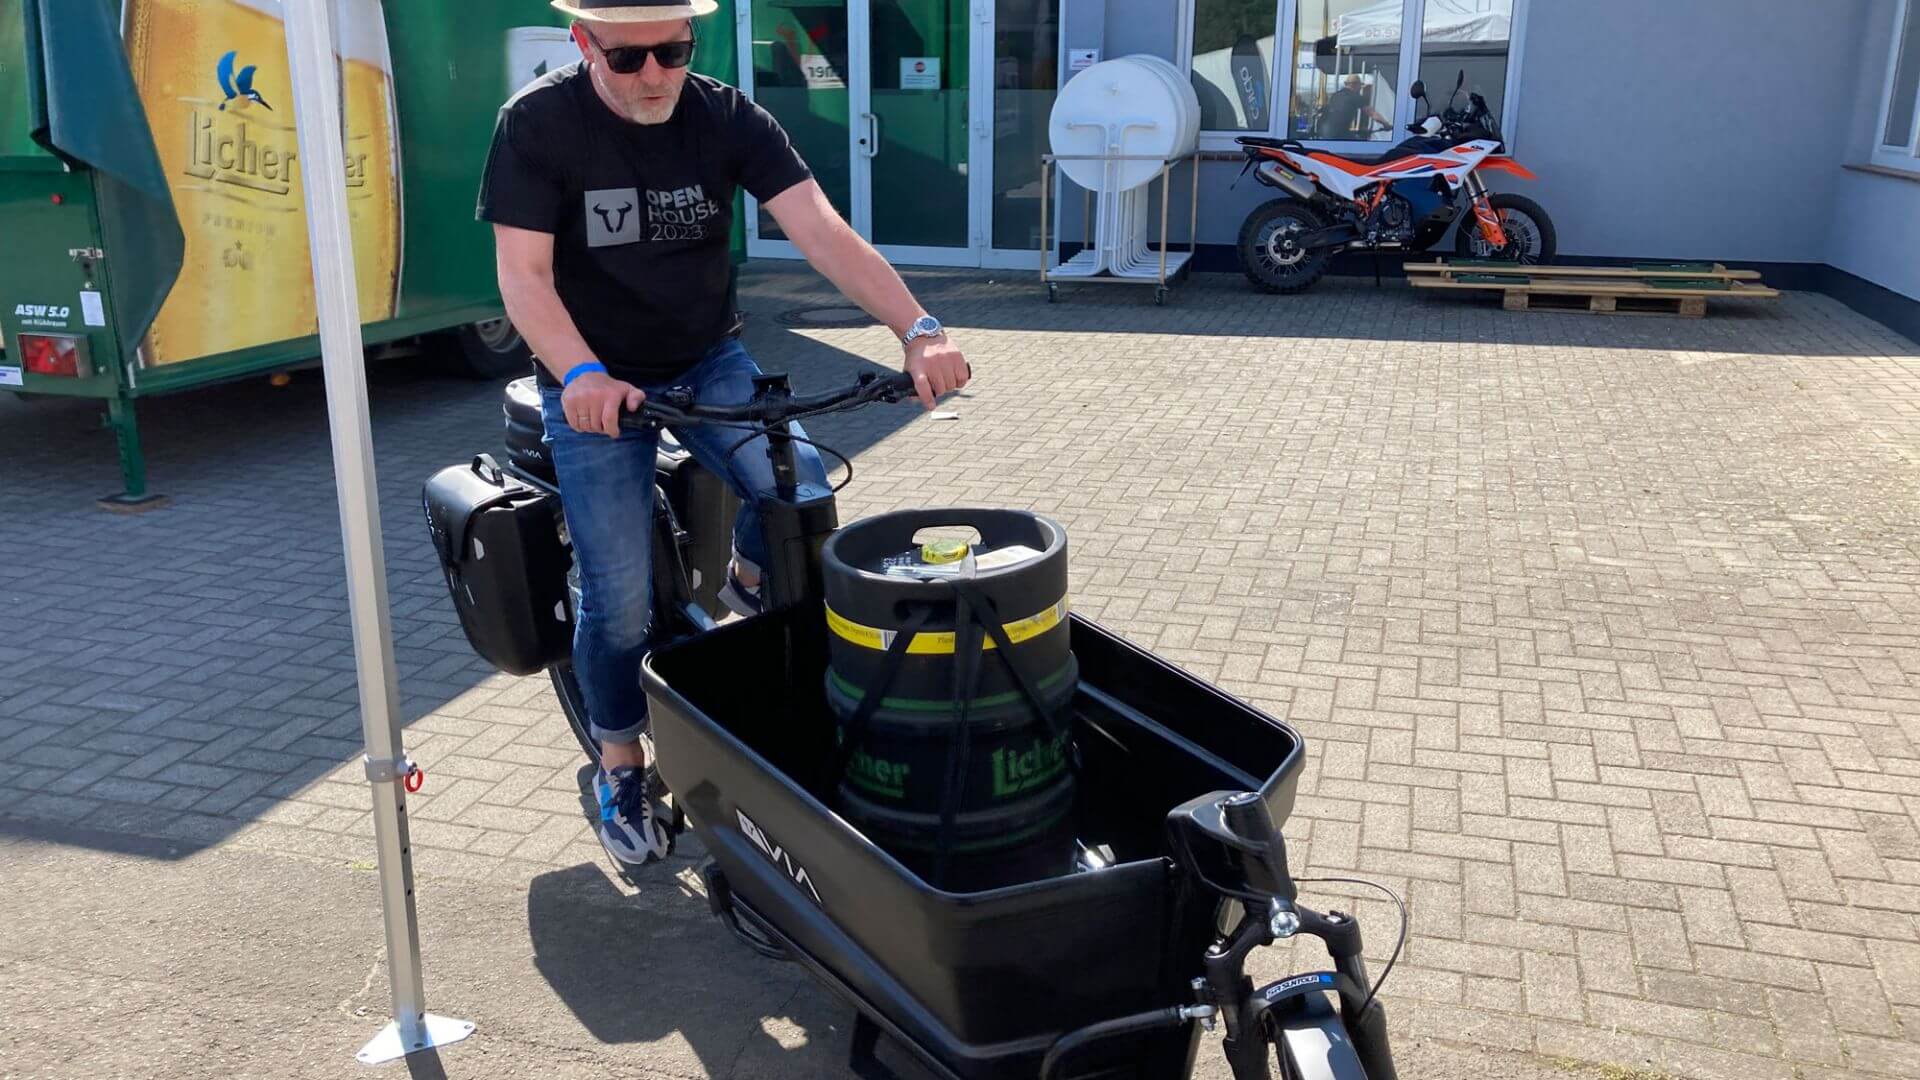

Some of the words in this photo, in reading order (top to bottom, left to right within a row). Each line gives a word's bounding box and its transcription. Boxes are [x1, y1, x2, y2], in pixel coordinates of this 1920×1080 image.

[184, 110, 297, 196] Licher
[646, 184, 704, 208] OPEN
[648, 200, 719, 225] HOUSE
[651, 223, 704, 241] 2023
[15, 304, 47, 317] ASW
[48, 306, 70, 318] 5.0
